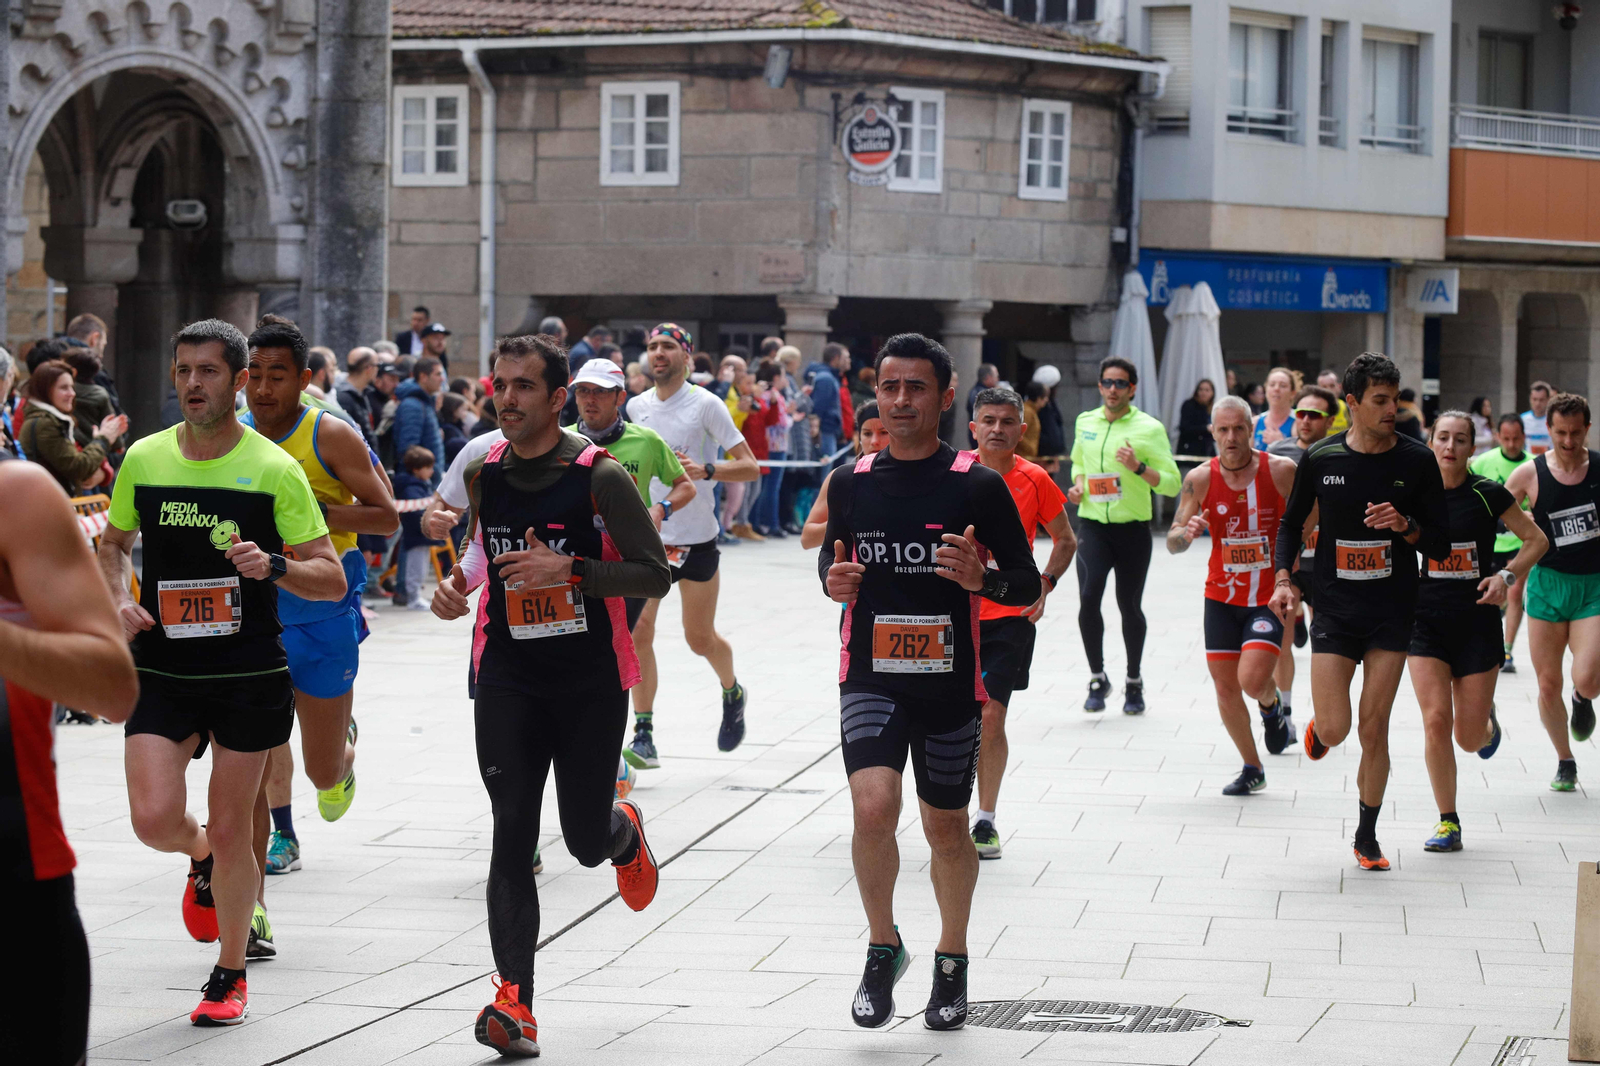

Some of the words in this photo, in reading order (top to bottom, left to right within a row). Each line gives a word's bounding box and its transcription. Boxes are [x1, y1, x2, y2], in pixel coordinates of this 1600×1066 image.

[852, 125, 891, 139] Estrella
[852, 139, 890, 152] Galicia
[160, 501, 199, 515] MEDIA
[159, 512, 219, 528] LARANXA
[1561, 516, 1587, 537] 1815
[1231, 548, 1257, 564] 603
[1346, 552, 1377, 570] 834
[179, 596, 214, 623] 216
[521, 596, 557, 624] 614
[889, 633, 930, 658] 262
